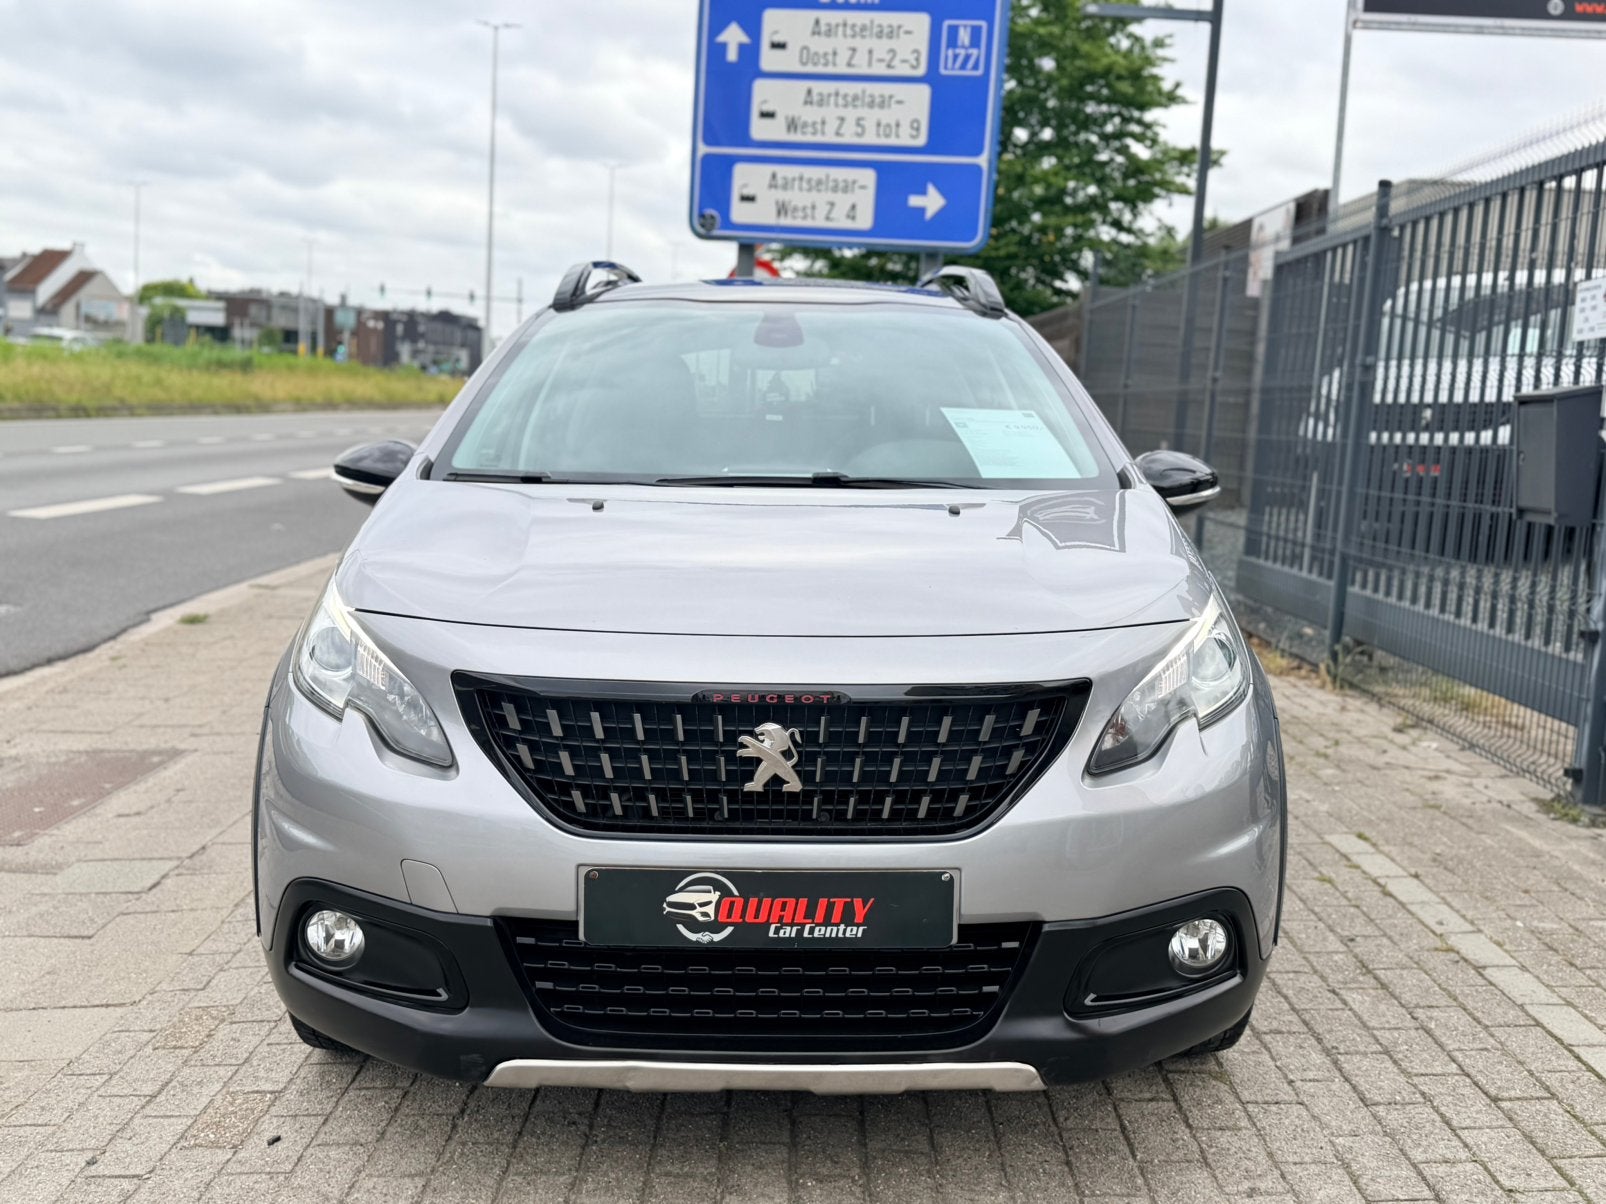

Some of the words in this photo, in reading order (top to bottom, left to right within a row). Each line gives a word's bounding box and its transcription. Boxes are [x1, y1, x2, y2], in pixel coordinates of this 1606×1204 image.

[810, 17, 914, 38] Aartselaar-
[957, 26, 971, 47] N
[799, 45, 838, 67] Oost
[867, 47, 922, 70] 1-2-3
[946, 48, 979, 71] 177
[803, 87, 905, 110] Aartselaar-
[784, 114, 827, 135] West
[876, 119, 901, 139] tot
[909, 117, 921, 140] 9
[768, 171, 868, 194] Aartselaar-
[775, 198, 817, 221] West
[846, 202, 857, 222] 4
[713, 693, 832, 704] PEUGEOT
[718, 897, 875, 924] QUALITY
[768, 923, 801, 938] Car
[803, 923, 867, 938] Center
